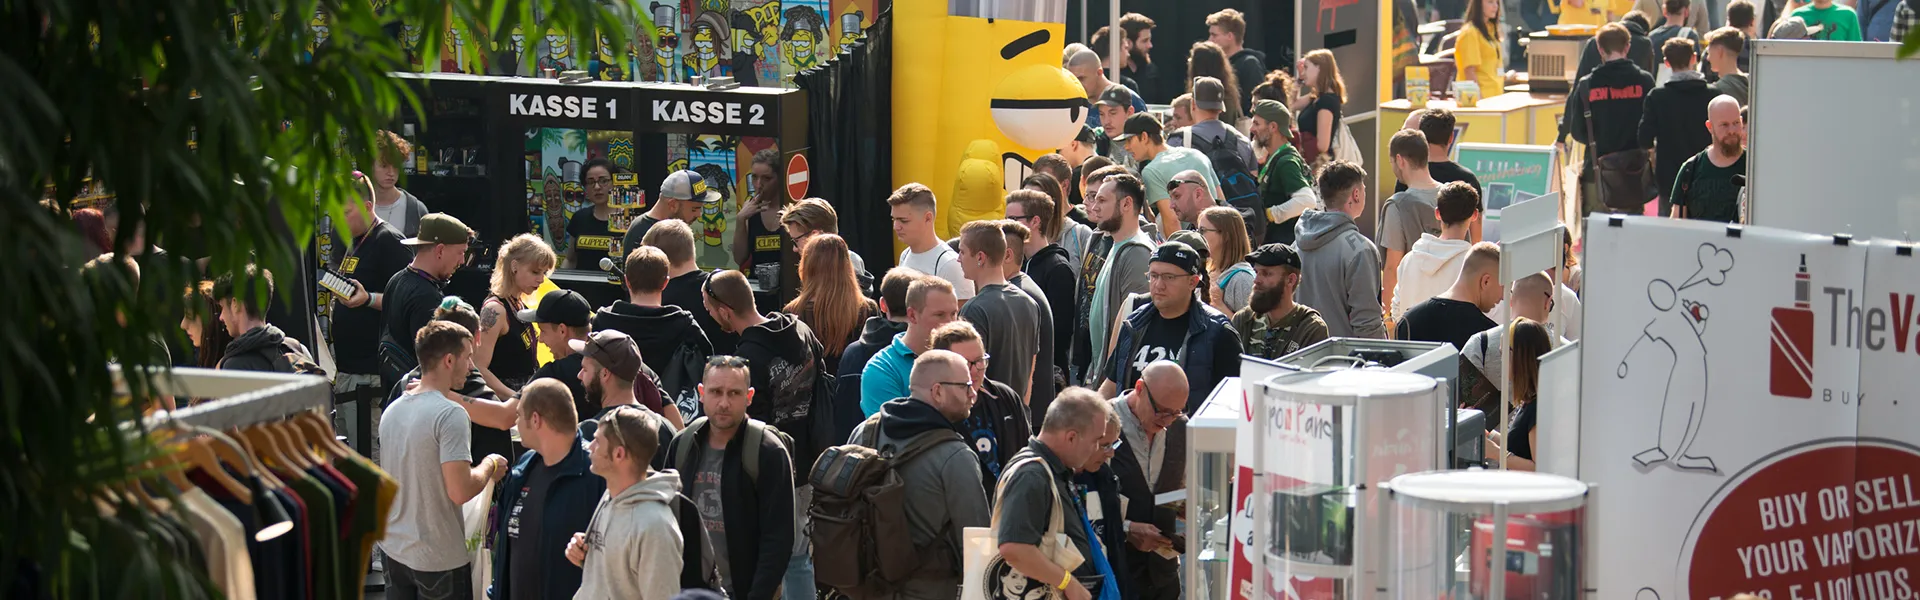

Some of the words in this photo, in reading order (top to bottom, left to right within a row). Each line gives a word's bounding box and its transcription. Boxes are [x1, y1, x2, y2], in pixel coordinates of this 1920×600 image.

[509, 93, 598, 119] KASSE
[605, 98, 617, 120] 1
[652, 100, 742, 125] KASSE
[749, 104, 765, 125] 2
[1823, 286, 1920, 356] TheV
[1823, 388, 1865, 406] BUY
[1758, 491, 1807, 531] BUY
[1818, 485, 1850, 521] OR
[1855, 474, 1920, 514] SELL
[1737, 539, 1808, 579] YOUR
